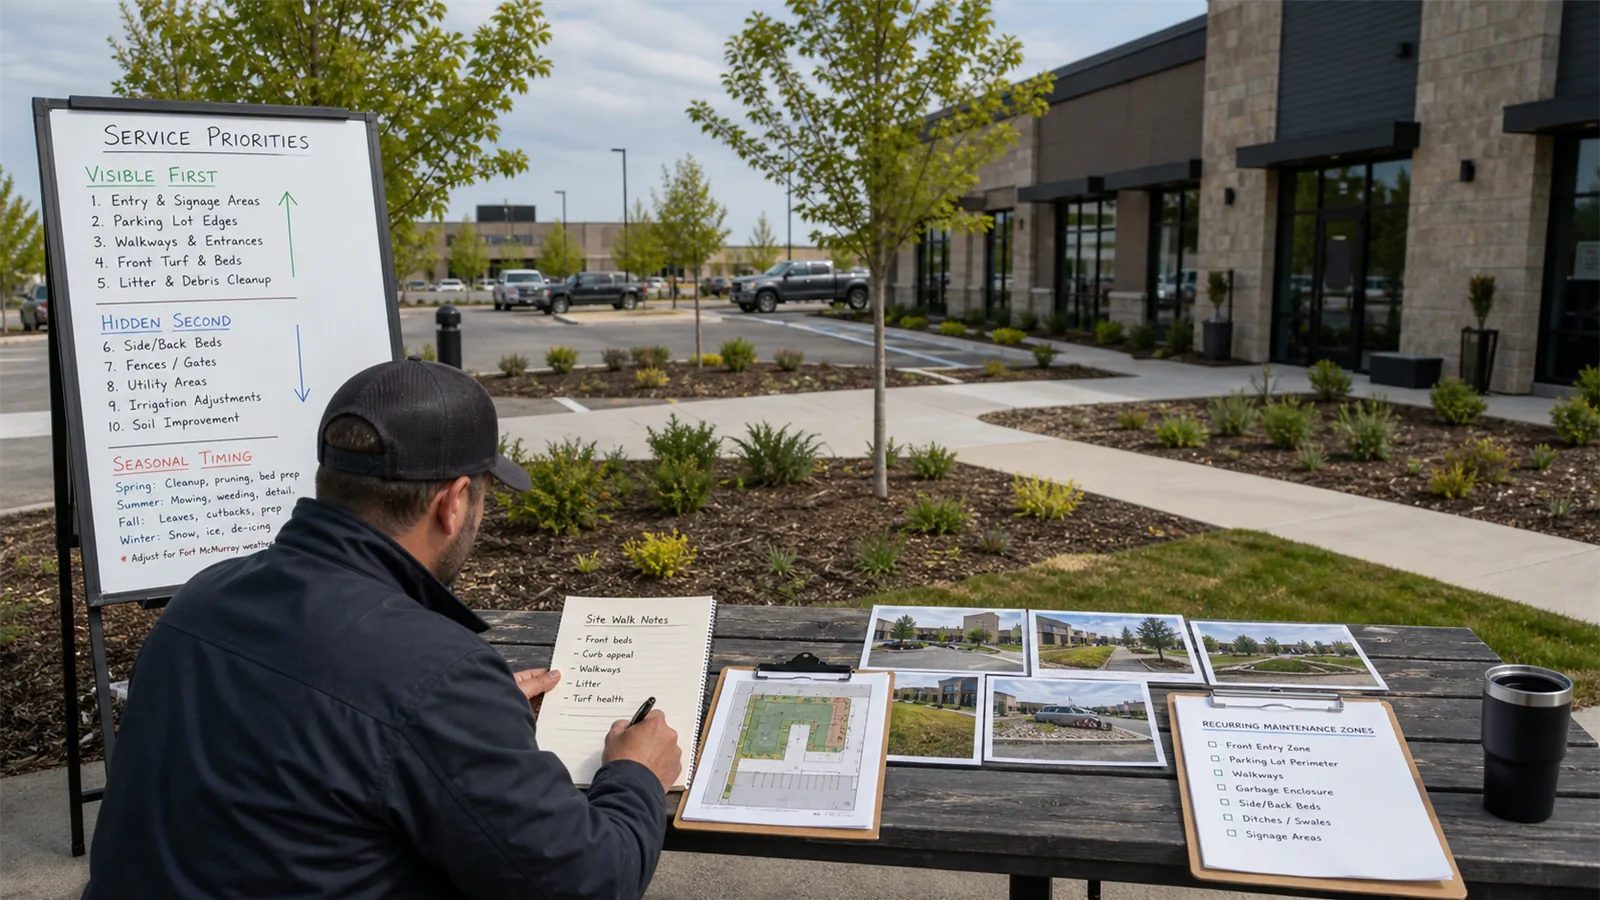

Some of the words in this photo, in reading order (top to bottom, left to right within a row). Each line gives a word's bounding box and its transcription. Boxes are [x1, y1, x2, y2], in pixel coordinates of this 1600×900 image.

[104, 124, 191, 146] SERVICE
[206, 125, 310, 150] PRIORITIES
[84, 165, 155, 183] VISIBLE
[168, 165, 218, 183] FIRST
[91, 194, 101, 207] 1.
[111, 193, 149, 211] Entry
[156, 193, 166, 207] &
[173, 193, 221, 211] Signage
[227, 194, 260, 207] Areas
[91, 215, 105, 228] 2.
[113, 213, 164, 232] Parking
[172, 214, 194, 227] Lot
[202, 214, 238, 231] Edges
[93, 235, 106, 248] 3.
[114, 235, 178, 252] Walkways
[187, 234, 197, 247] &
[205, 234, 264, 247] Entrances
[94, 256, 108, 269] 4.
[117, 255, 153, 269] Front
[160, 254, 190, 268] Turf
[197, 254, 207, 267] &
[213, 254, 242, 266] Beds
[97, 277, 110, 290] 5.
[119, 276, 157, 289] Litter
[165, 274, 175, 288] &
[181, 274, 220, 287] Debris
[226, 273, 272, 288] Cleanup
[101, 314, 162, 331] HIDDEN
[172, 312, 232, 328] SECOND
[102, 341, 115, 353] 6.
[124, 337, 187, 352] Side/Back
[194, 336, 223, 349] Beds
[104, 361, 117, 373] 7.
[126, 358, 167, 372] Fences
[172, 356, 179, 371] /
[183, 356, 217, 369] Gates
[106, 380, 119, 393] 8.
[127, 378, 168, 394] Utility
[174, 376, 208, 388] Areas
[107, 400, 121, 413] 9.
[128, 397, 187, 414] Irrigation
[193, 391, 262, 410] Adjustments
[108, 421, 124, 433] 10.
[132, 418, 156, 431] Soil
[163, 412, 240, 431] Improvement
[112, 455, 190, 472] SEASONAL
[198, 449, 253, 465] TIMING
[115, 481, 156, 496] Spring:
[164, 477, 210, 490] Cleanup,
[214, 473, 254, 488] pruning,
[258, 470, 276, 481] bed
[279, 469, 301, 483] prep
[116, 499, 164, 511] Summer:
[170, 494, 212, 506] Mowing,
[216, 489, 259, 502] weeding,
[265, 485, 296, 497] detail.
[118, 515, 145, 528] Fall:
[159, 513, 199, 524] Leaves,
[205, 507, 255, 519] cutbacks,
[260, 503, 283, 517] prep
[119, 533, 161, 546] Winter:
[168, 529, 200, 541] Snow,
[206, 526, 225, 537] ice,
[230, 522, 272, 536] de-icing
[131, 551, 160, 565] Adjust
[162, 549, 176, 559] for
[178, 547, 197, 557] Fort
[199, 544, 240, 555] McMurray
[585, 613, 606, 625] Site
[611, 614, 636, 625] Walk
[640, 615, 669, 625] Notes
[585, 634, 609, 644] Front
[612, 635, 633, 645] beds
[582, 649, 604, 659] Curb
[606, 650, 634, 661] appeal
[579, 664, 622, 676] Walkways
[575, 679, 602, 688] Litter
[572, 693, 593, 703] Turf
[596, 694, 624, 703] health
[1202, 720, 1260, 731] RECURRING
[1263, 723, 1337, 734] MAINTENANCE
[1339, 726, 1375, 735] ZONES
[1225, 741, 1253, 750] Front
[1255, 742, 1284, 754] Entry
[1286, 744, 1311, 753] Zone
[1228, 755, 1268, 767] Parking
[1269, 758, 1286, 766] Lot
[1289, 758, 1339, 768] Perimeter
[1231, 770, 1284, 782] Walkways
[1235, 784, 1280, 796] Garbage
[1282, 786, 1334, 796] Enclosure
[1238, 799, 1293, 809] Side/Back
[1295, 802, 1322, 811] Beds
[1242, 814, 1283, 825] Ditches
[1285, 816, 1291, 826] /
[1294, 817, 1332, 827] Swales
[1245, 829, 1288, 843] Signage
[1291, 832, 1323, 842] Areas
